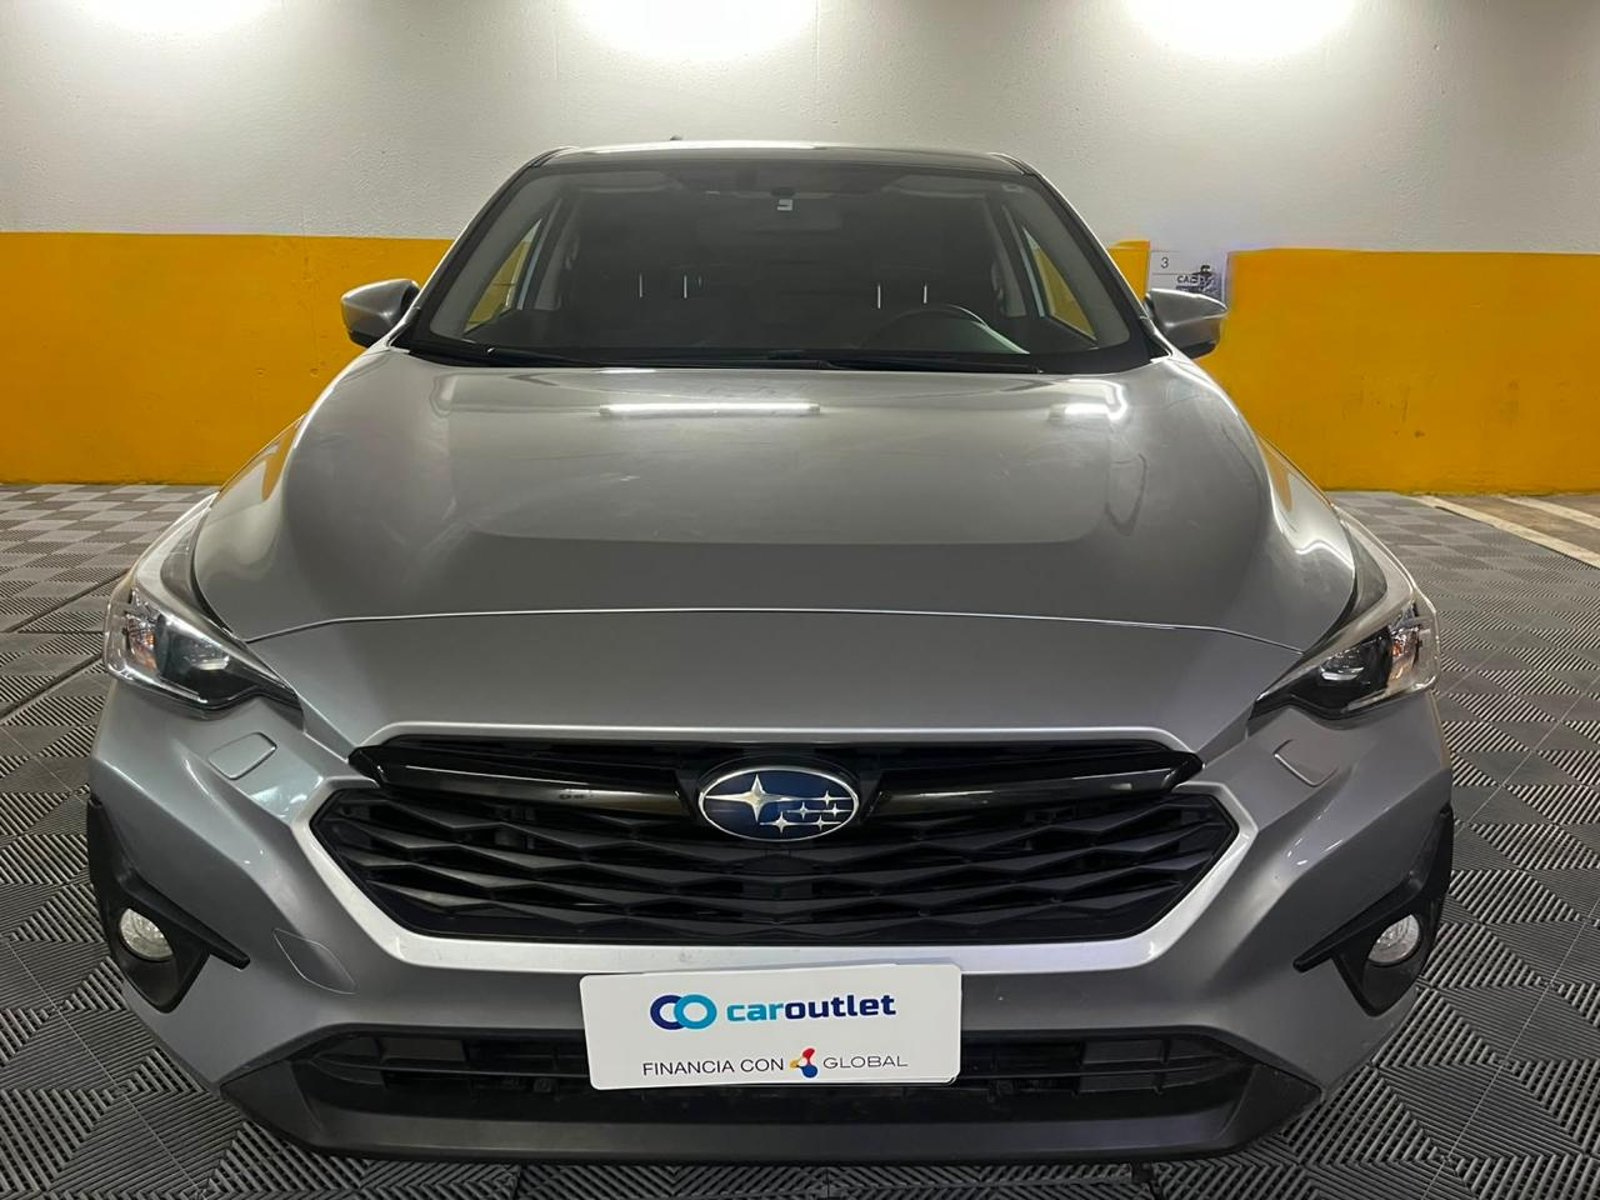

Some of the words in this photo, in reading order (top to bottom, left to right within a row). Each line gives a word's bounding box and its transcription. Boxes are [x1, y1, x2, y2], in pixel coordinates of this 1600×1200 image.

[1160, 256, 1170, 269] 3
[726, 994, 897, 1022] caroutlet
[642, 1060, 736, 1076] FINANCIA
[740, 1058, 784, 1074] CON
[822, 1054, 908, 1071] GLOBAL
